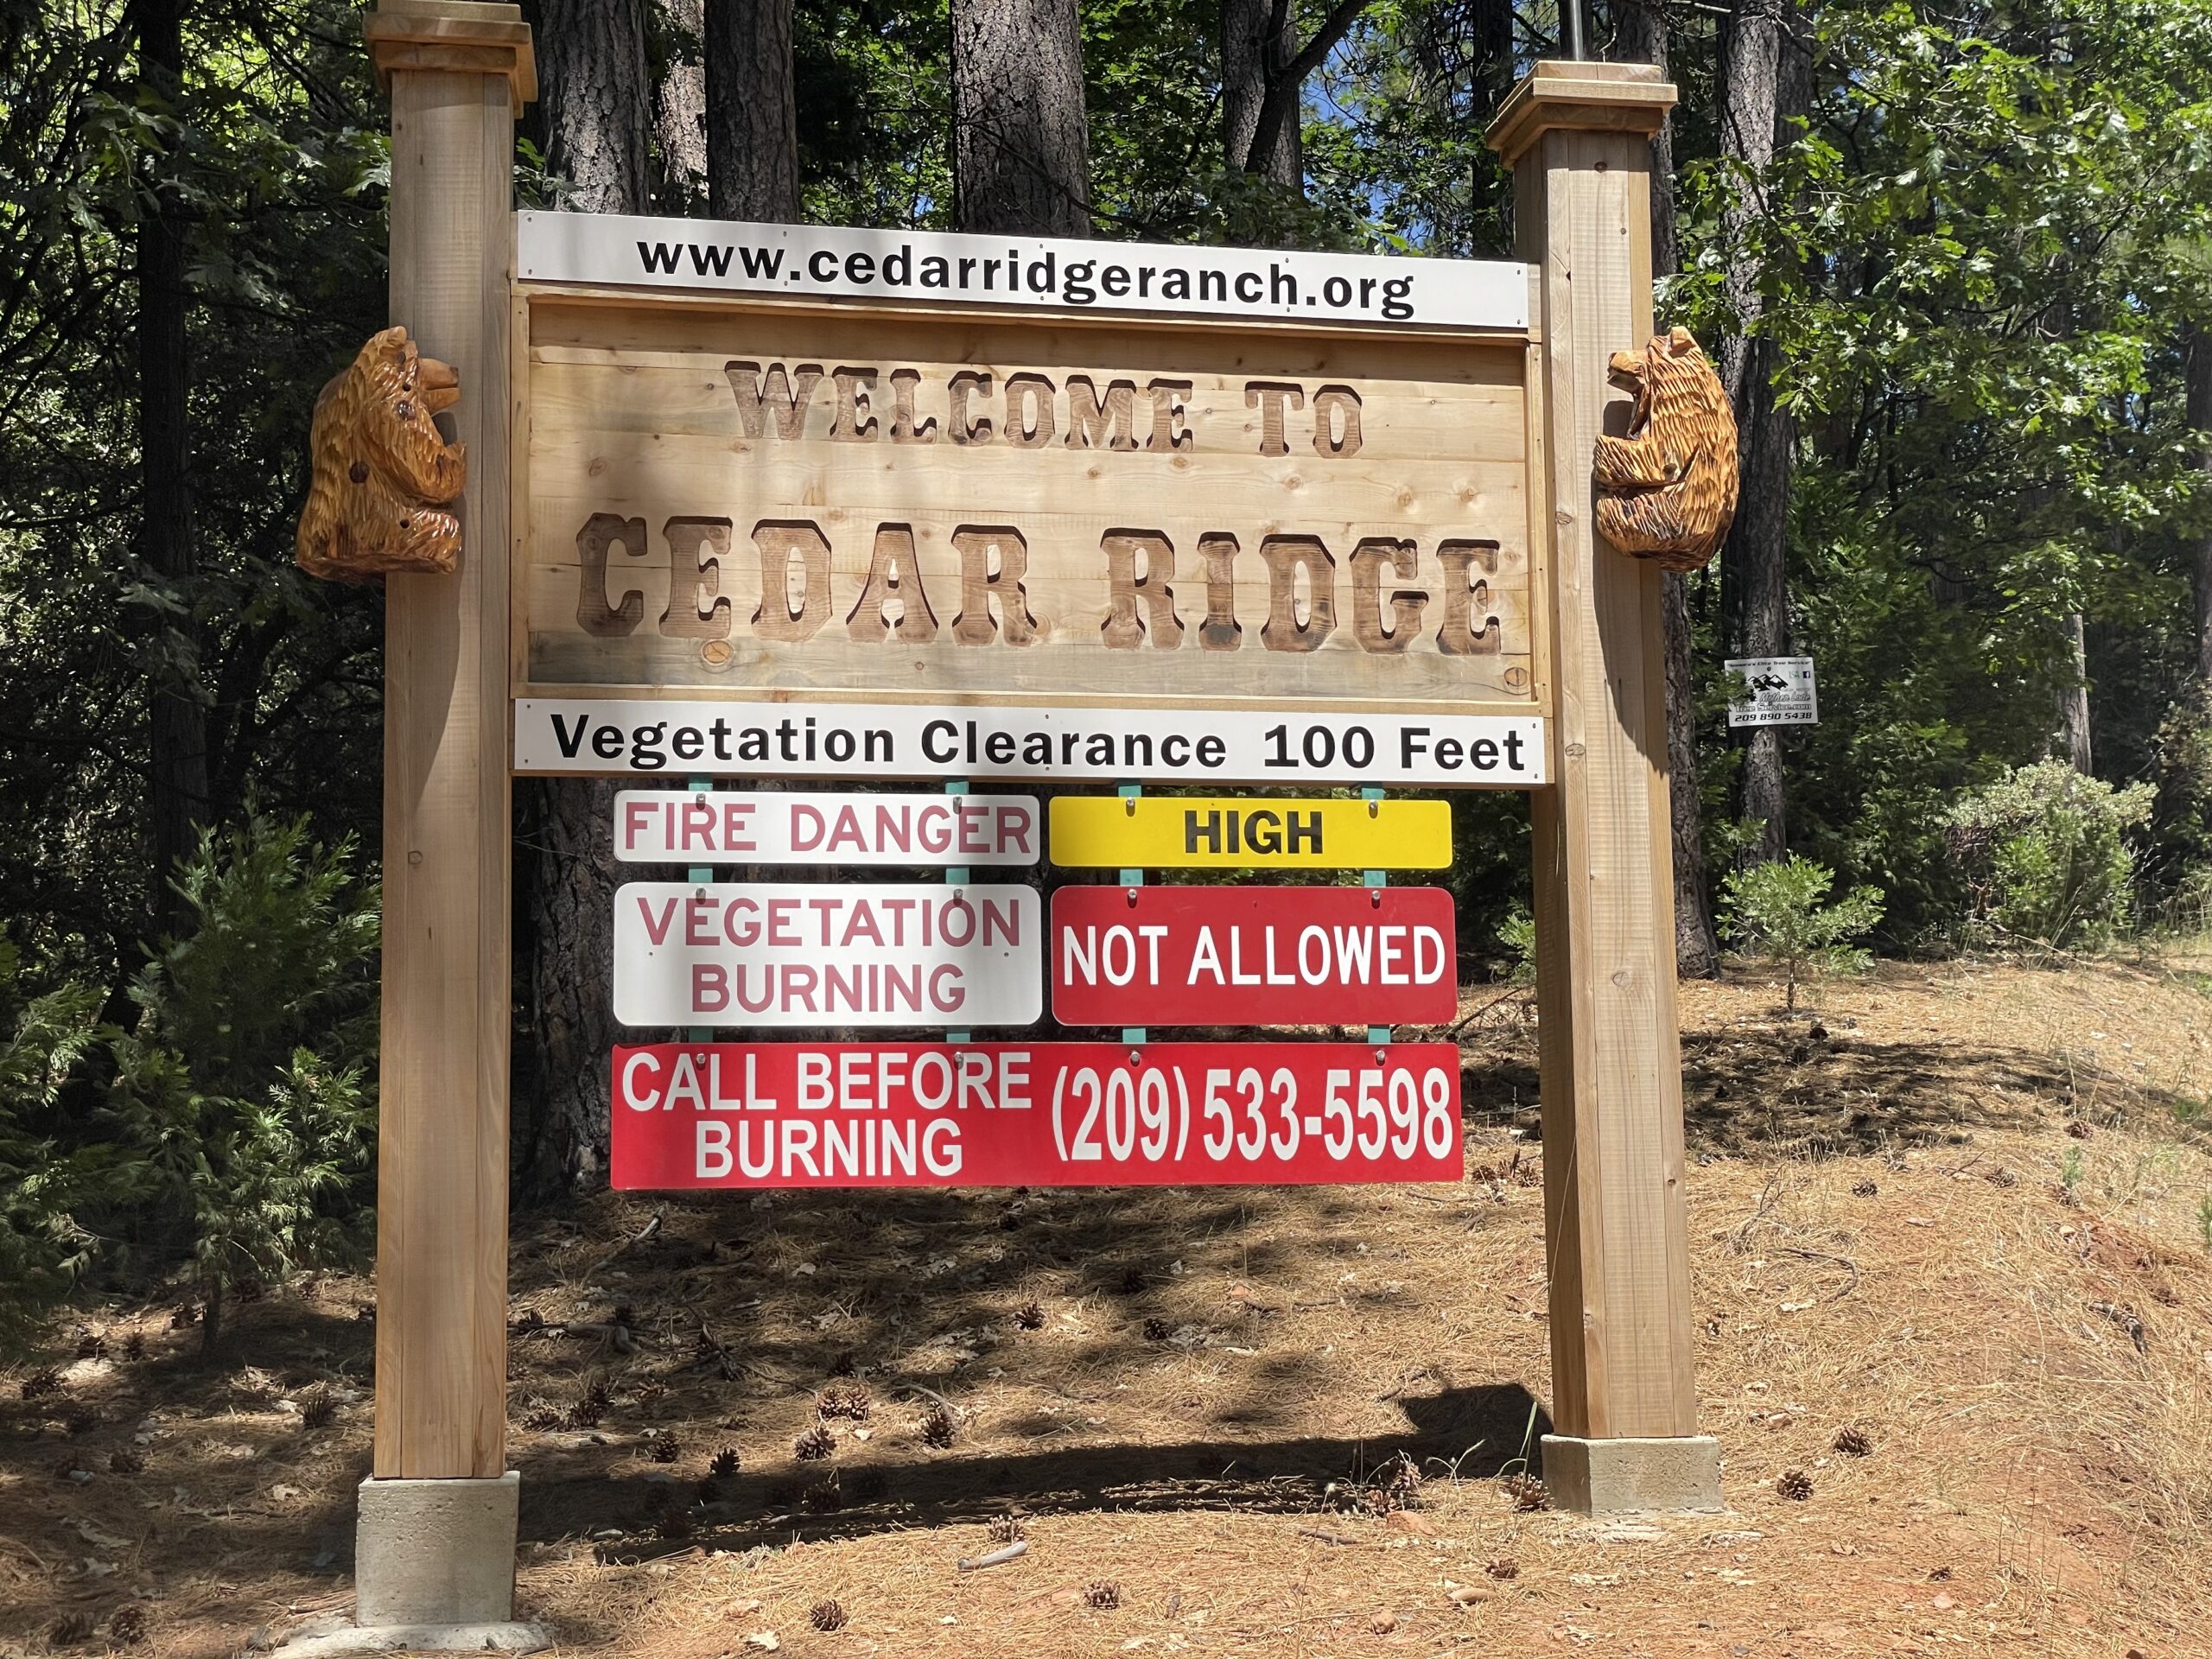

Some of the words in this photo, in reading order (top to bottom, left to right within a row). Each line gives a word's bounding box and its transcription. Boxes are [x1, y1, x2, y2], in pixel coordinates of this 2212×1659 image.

[636, 241, 1414, 320] www.cedarridgeranch.org
[724, 360, 1194, 453] WELCOME
[1244, 380, 1363, 459] TO
[575, 512, 1038, 647] CEDAR
[1100, 527, 1501, 656] RIDGE
[1759, 692, 1790, 702] Mother
[550, 714, 894, 770] Vegetation
[921, 720, 1227, 767] Clearance
[1263, 724, 1375, 769] 100
[1401, 727, 1525, 771] Feet
[626, 802, 757, 851] FIRE
[790, 804, 1032, 854] DANGER
[1184, 810, 1324, 855] HIGH
[637, 897, 1020, 947] VEGETATION
[1064, 925, 1168, 986] NOT
[1186, 925, 1446, 986] ALLOWED
[691, 963, 966, 1013] BURNING
[622, 1052, 777, 1111] CALL
[798, 1051, 1032, 1110] BEFORE
[1052, 1065, 1190, 1161] (209)
[1203, 1067, 1453, 1161] 533-5598
[696, 1118, 963, 1178] BURNING
